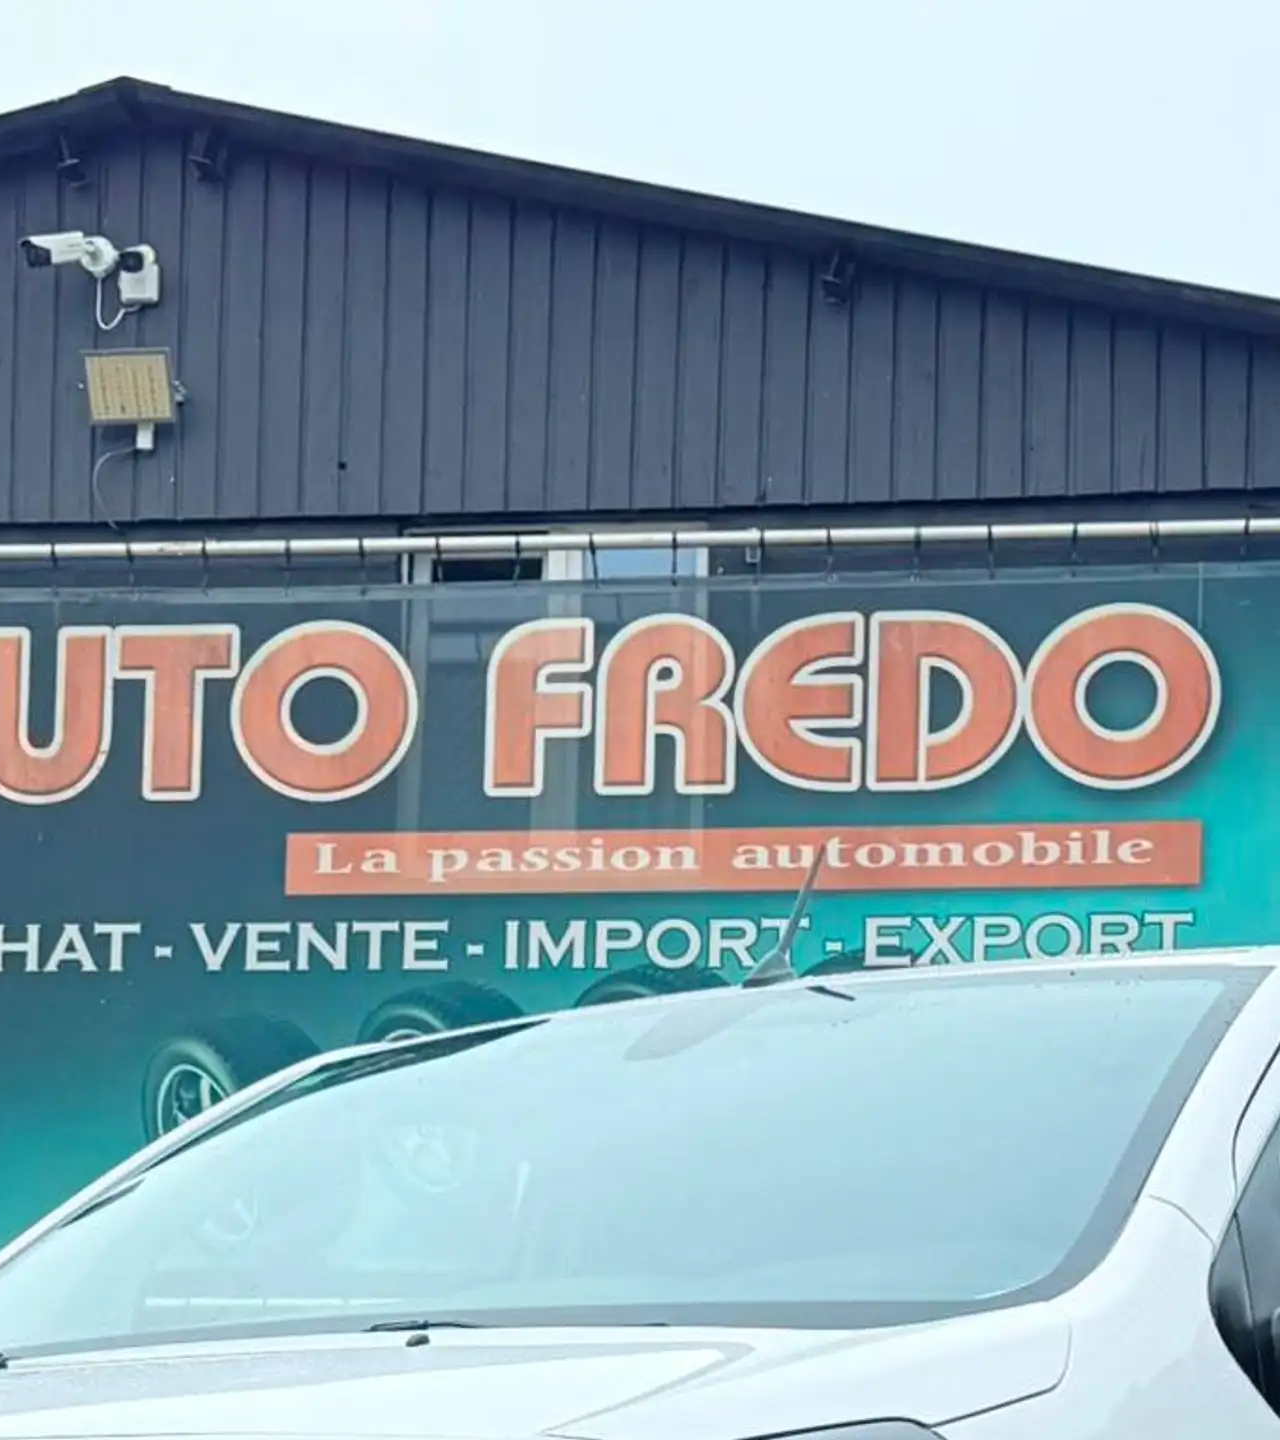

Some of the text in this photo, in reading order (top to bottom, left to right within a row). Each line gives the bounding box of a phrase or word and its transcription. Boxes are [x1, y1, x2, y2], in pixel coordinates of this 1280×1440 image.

[483, 602, 1222, 797] FREDO
[315, 829, 1155, 883] La passion automobile
[189, 920, 449, 972] VENTE
[505, 915, 811, 971] IMPORT
[864, 911, 1195, 968] EXPORT
